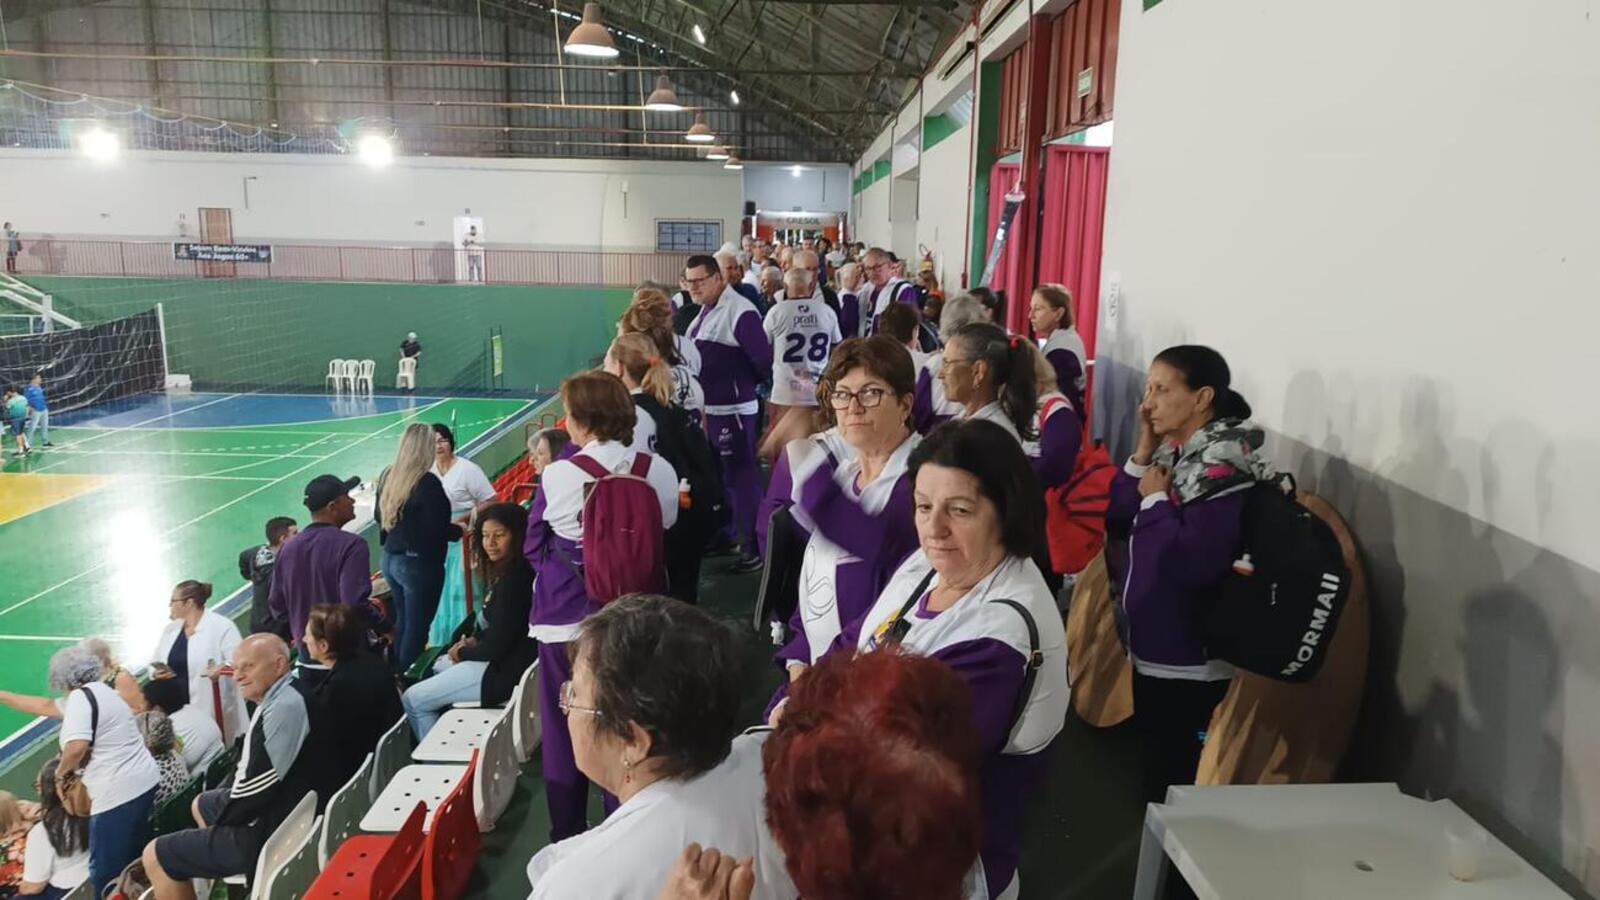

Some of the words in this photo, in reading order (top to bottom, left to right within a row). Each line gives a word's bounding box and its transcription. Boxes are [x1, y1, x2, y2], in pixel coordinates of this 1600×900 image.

[793, 312, 819, 328] prati
[783, 332, 829, 363] 28
[1281, 573, 1340, 675] MORMAII
